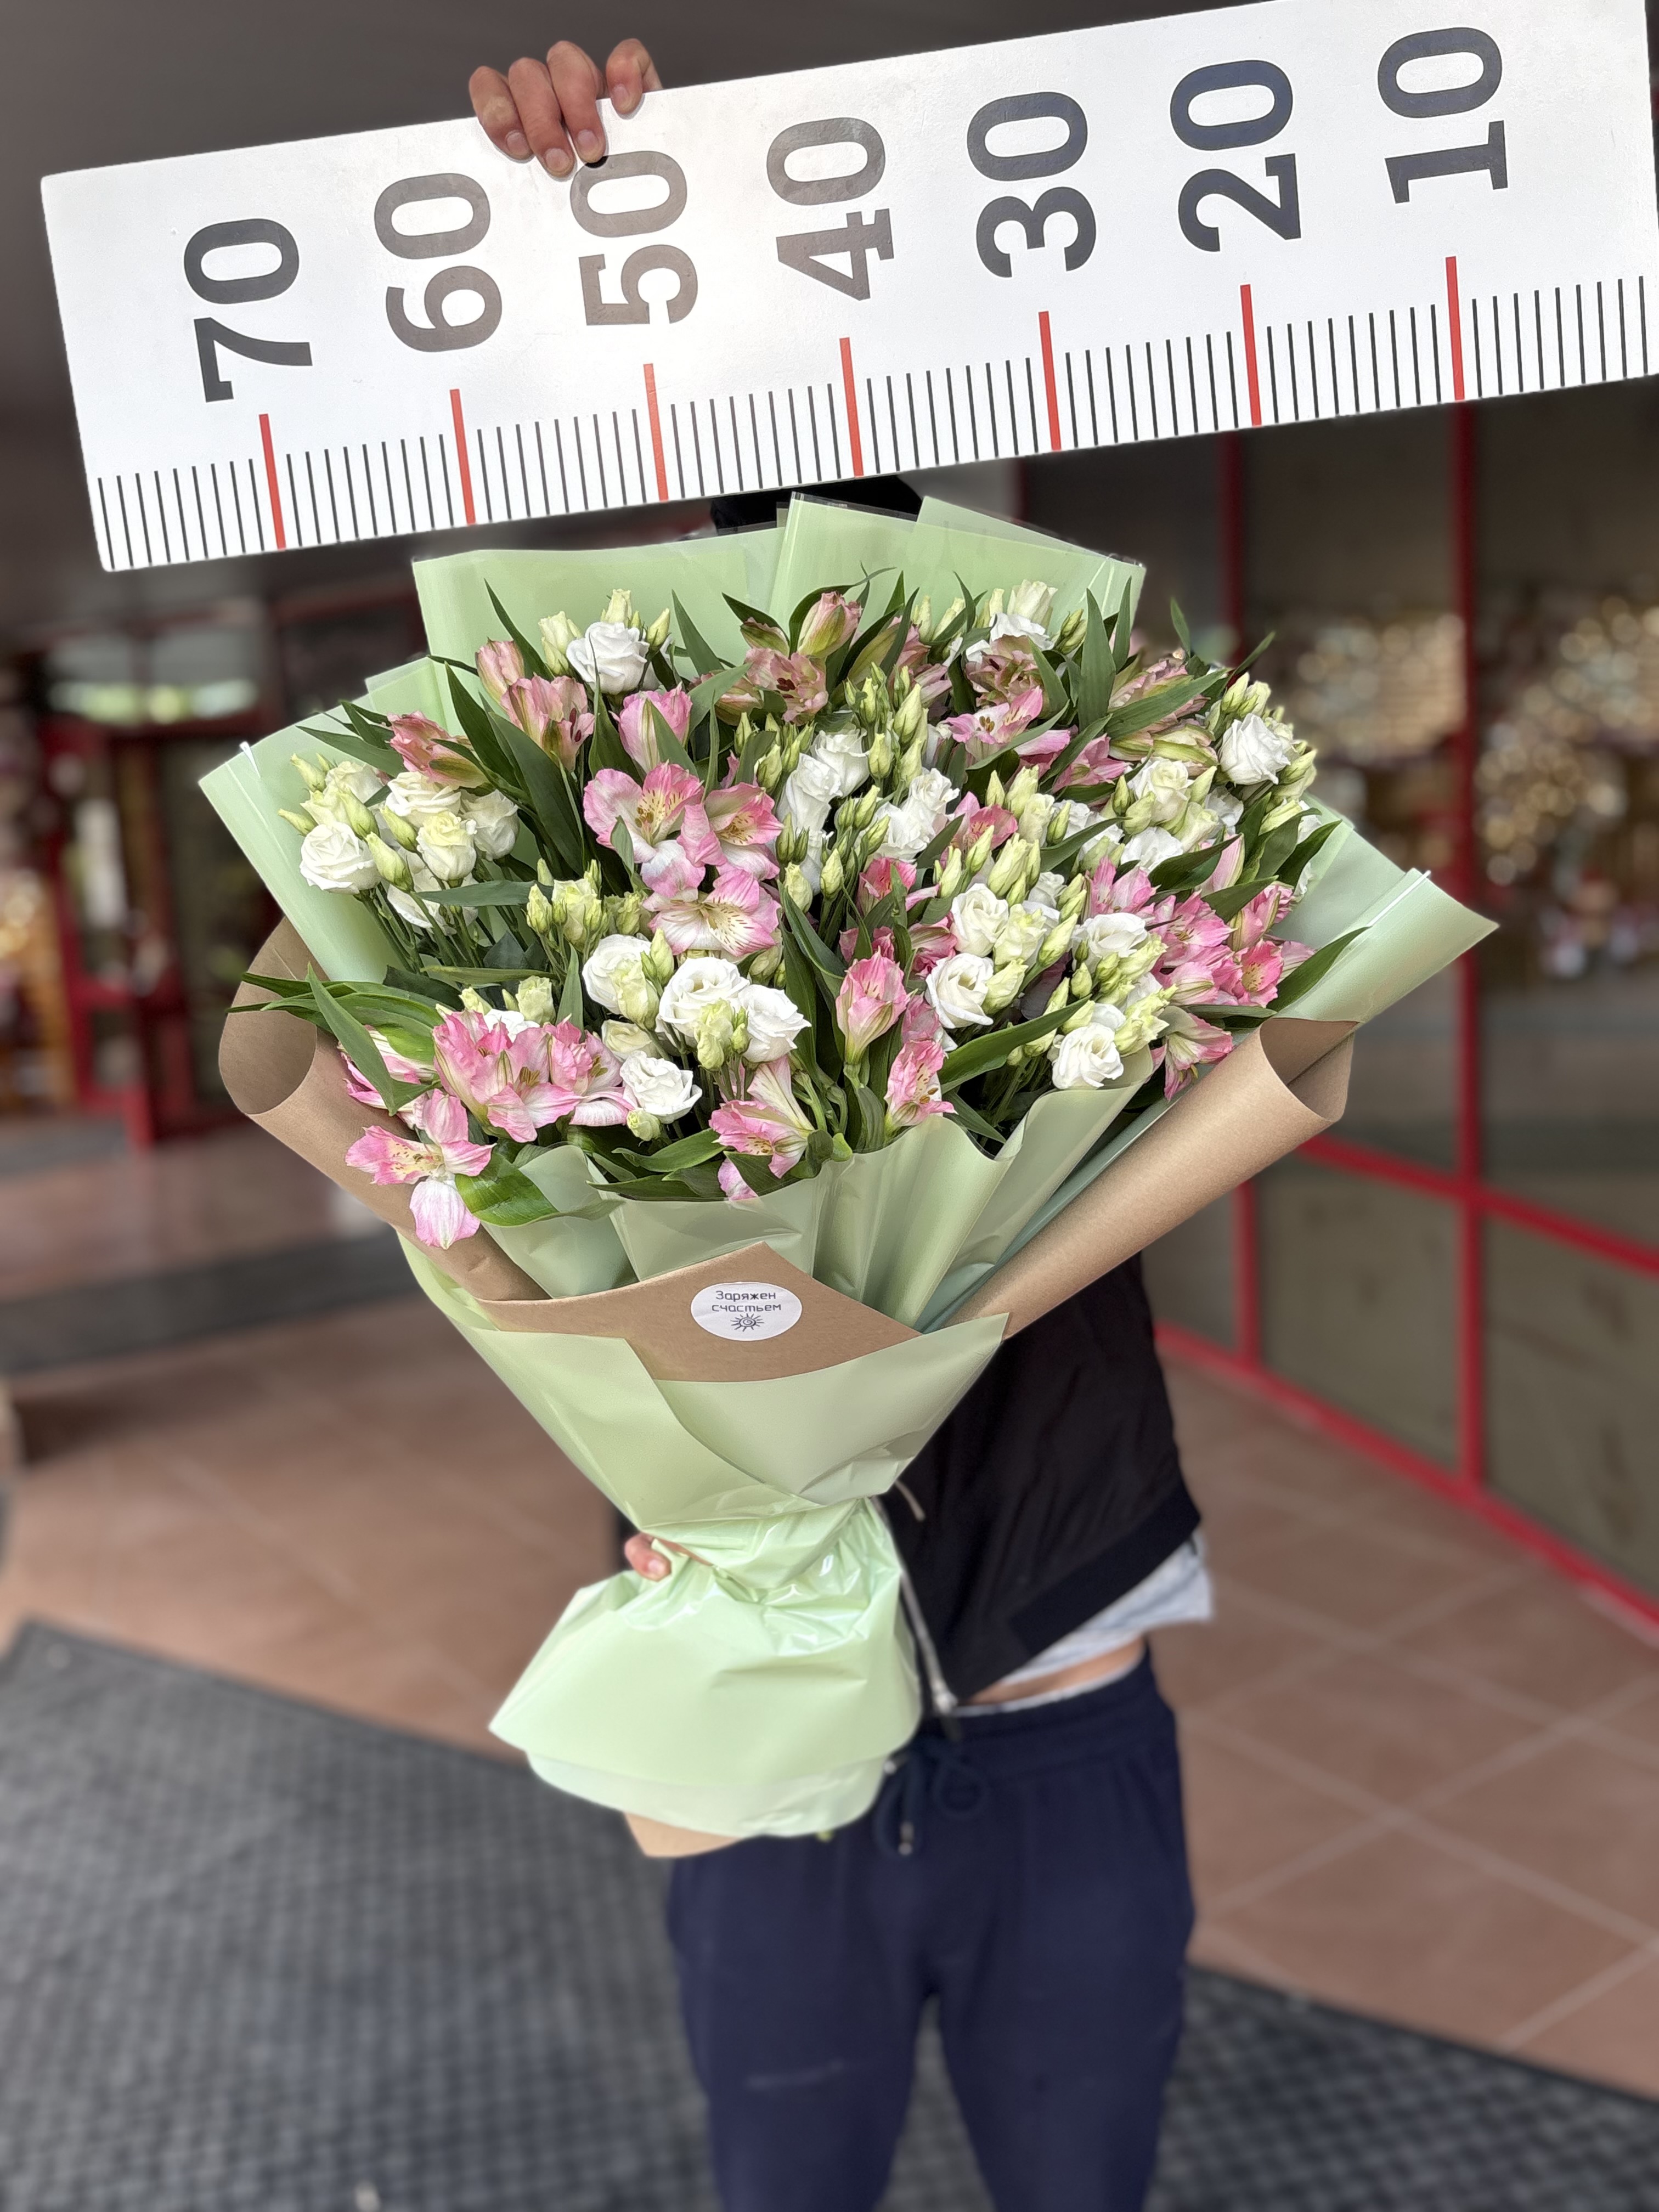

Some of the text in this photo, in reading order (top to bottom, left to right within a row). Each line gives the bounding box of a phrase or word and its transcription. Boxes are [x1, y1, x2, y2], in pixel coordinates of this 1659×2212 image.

[967, 92, 1096, 278] 30
[1170, 60, 1301, 252] 20
[1378, 27, 1508, 204] 10
[374, 173, 502, 352] 60
[569, 150, 698, 326] 50
[766, 117, 894, 301] 40
[184, 218, 312, 402] 70
[712, 1304, 781, 1312] счастьем
[715, 1290, 776, 1302] Заряжен
